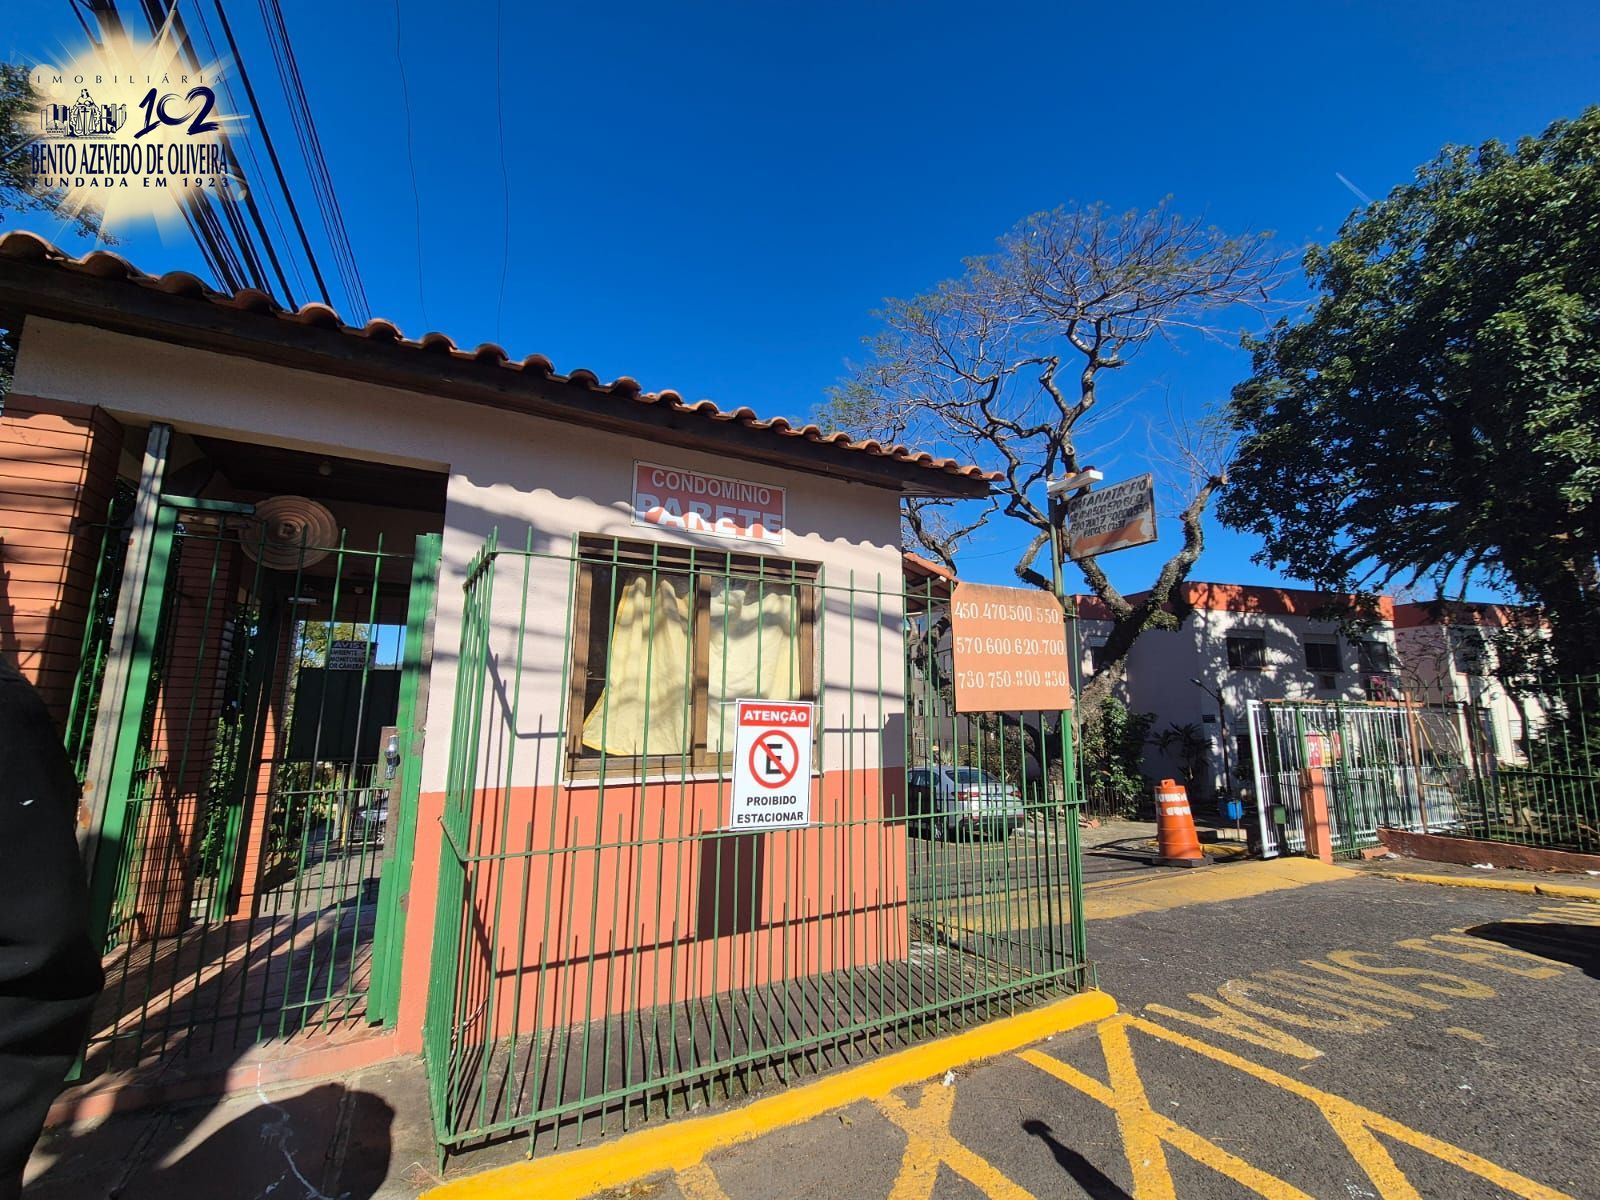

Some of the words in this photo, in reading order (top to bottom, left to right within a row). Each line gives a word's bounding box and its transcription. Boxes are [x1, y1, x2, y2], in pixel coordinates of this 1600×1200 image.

[955, 601, 979, 619] 450
[983, 603, 1007, 621] 470
[1009, 605, 1032, 622] 500
[956, 637, 983, 654] 570
[985, 637, 1011, 655] 600
[1014, 638, 1039, 655] 620
[1042, 639, 1065, 655] 700
[988, 670, 1012, 688] 750
[744, 709, 807, 724] ATENÇÃO
[766, 743, 783, 775] E
[746, 795, 797, 807] PROIBIDO
[737, 811, 804, 824] ESTACIONAR
